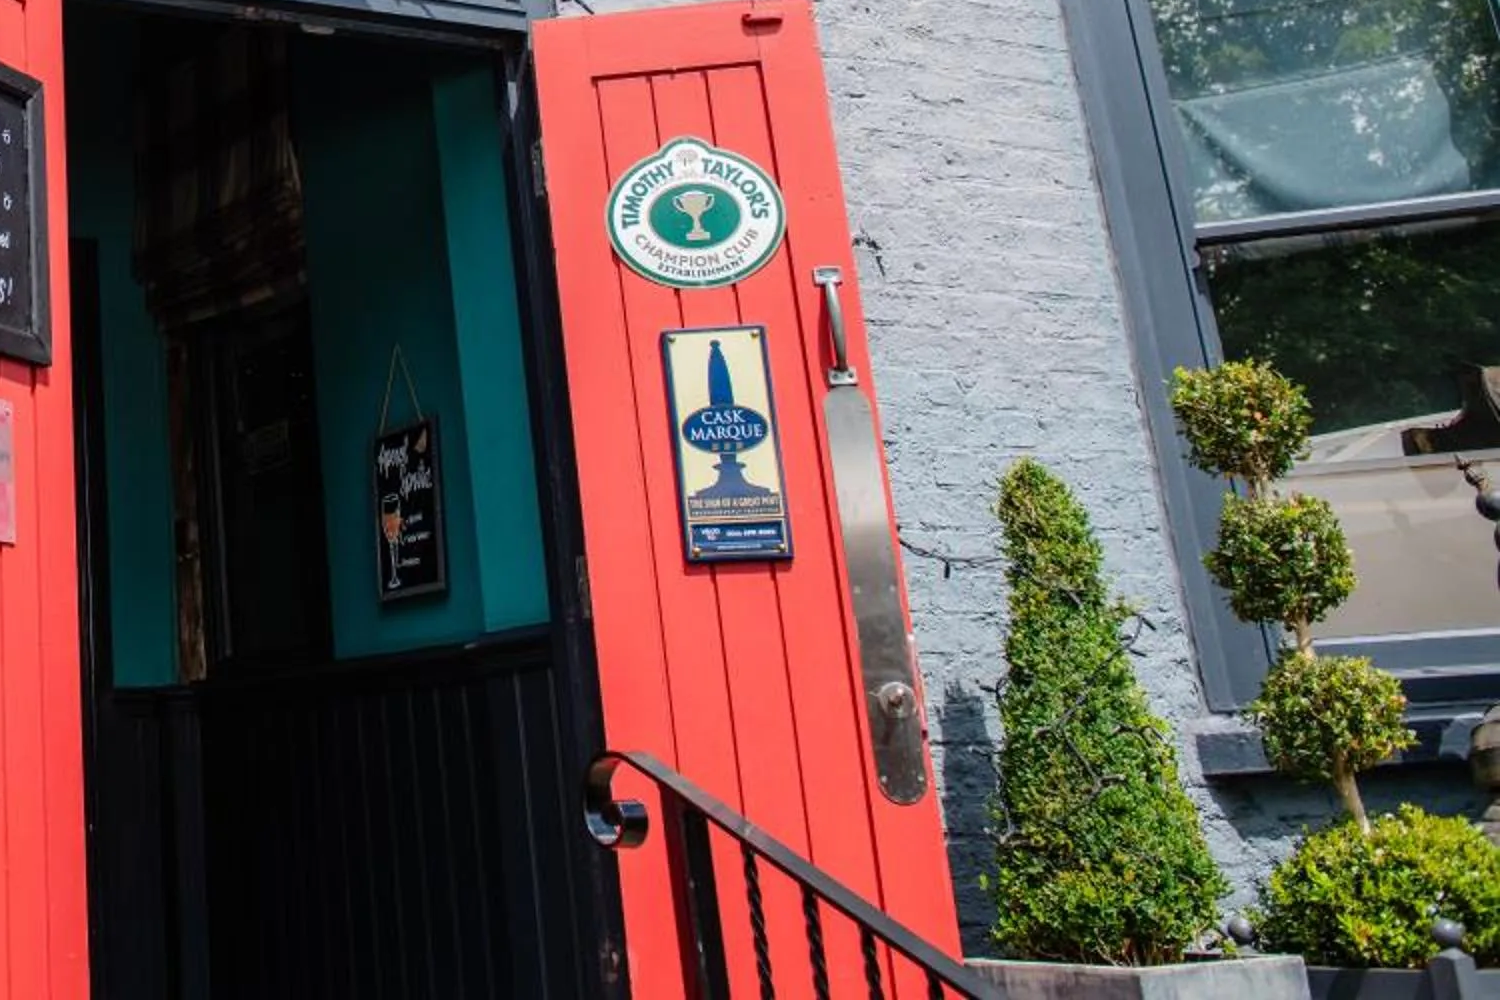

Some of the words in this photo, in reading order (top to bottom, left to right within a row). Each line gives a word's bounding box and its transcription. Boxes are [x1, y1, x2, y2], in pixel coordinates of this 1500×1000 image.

[621, 159, 675, 230] TIMOTHY
[700, 156, 770, 220] TAYLOR'S
[634, 233, 721, 267] CHAMPION
[723, 227, 759, 260] CLUB
[657, 255, 746, 278] ESTABLISHMENT
[700, 409, 747, 426] CASK
[690, 423, 764, 442] MARQUE
